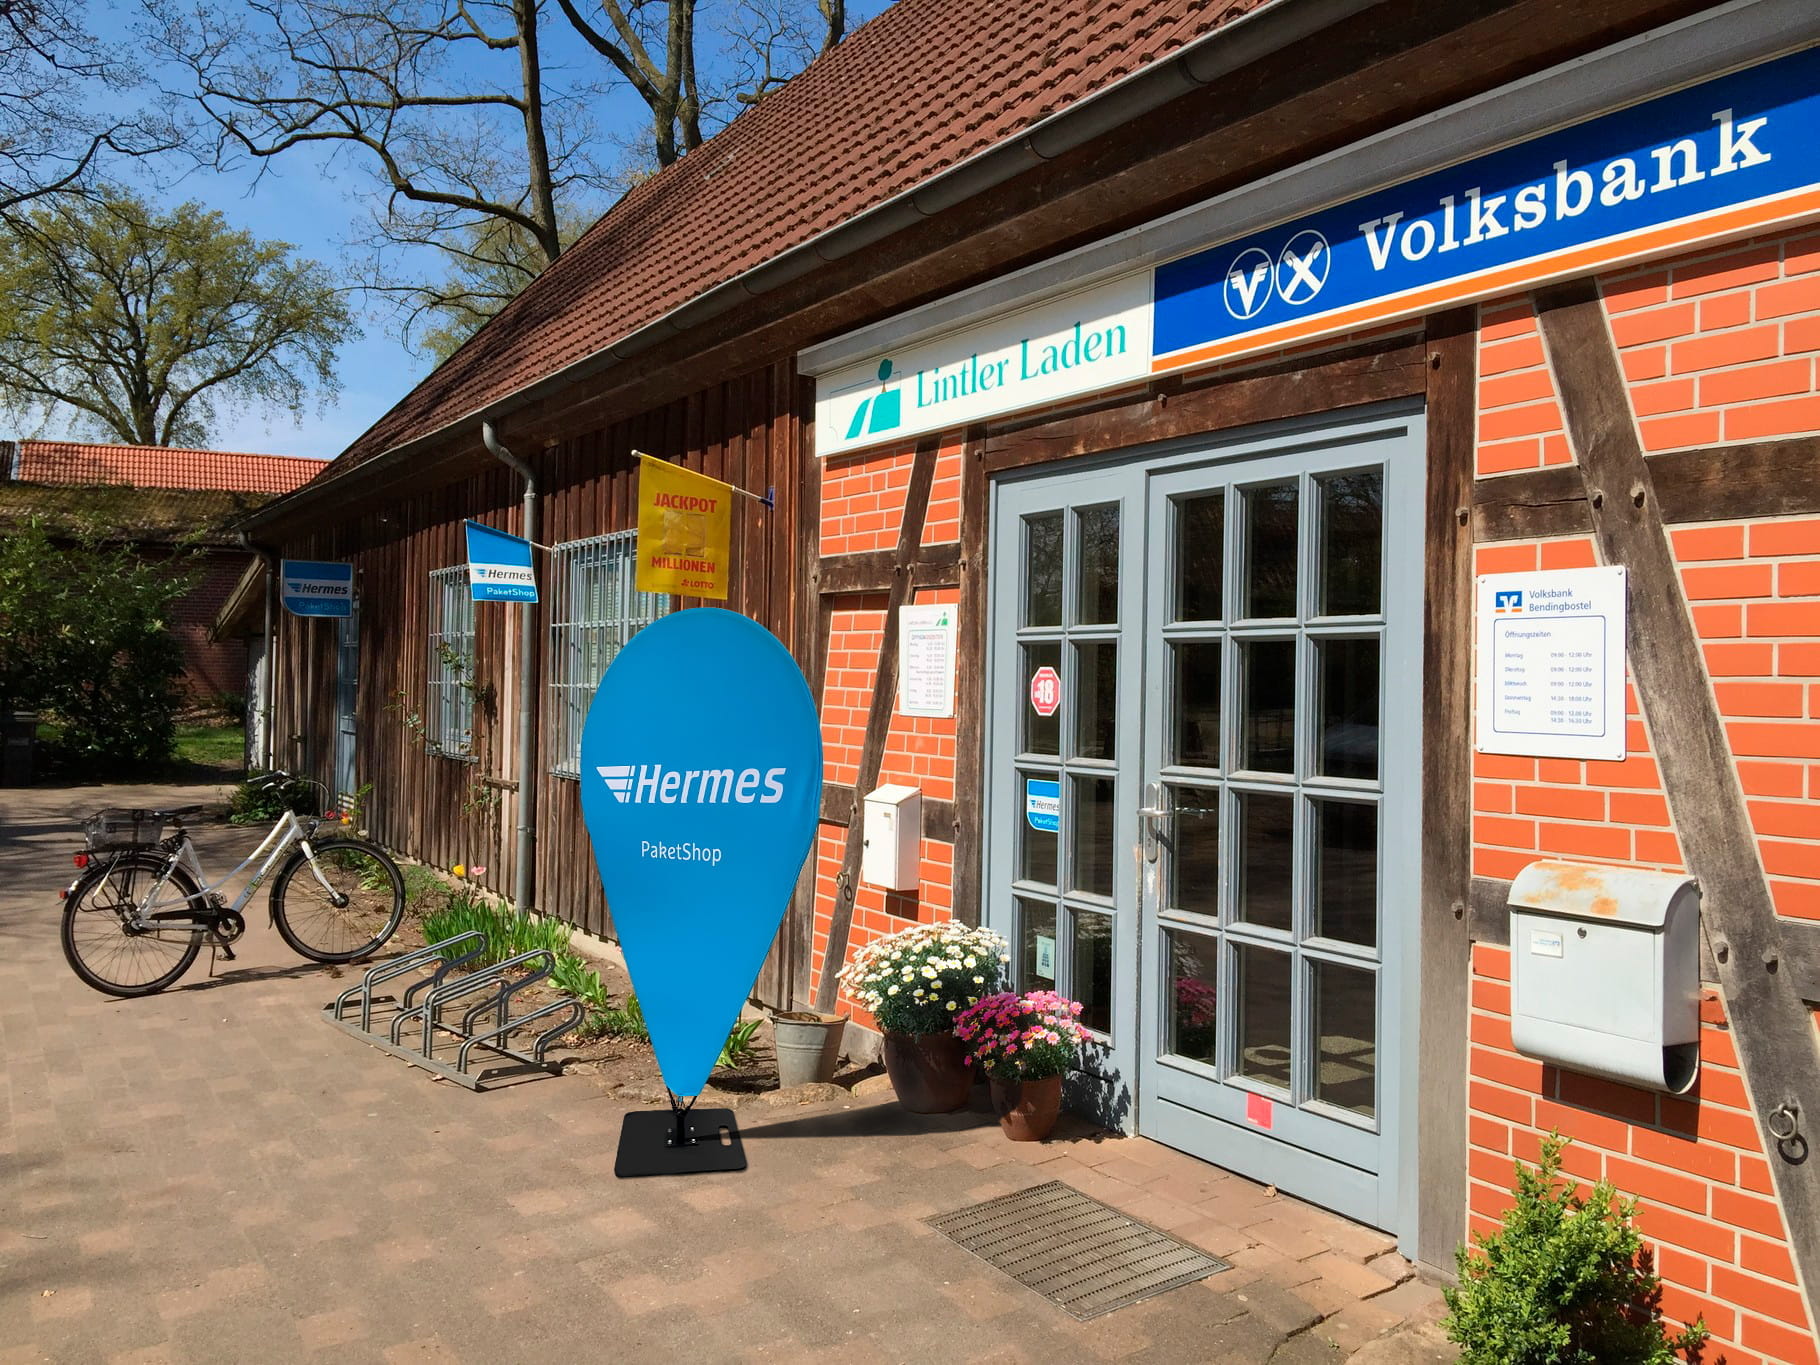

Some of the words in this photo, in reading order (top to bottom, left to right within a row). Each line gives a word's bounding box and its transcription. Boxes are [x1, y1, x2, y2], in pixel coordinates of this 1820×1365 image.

[1358, 108, 1771, 271] Volksbank
[916, 353, 1009, 408] Lintler
[1020, 321, 1127, 380] Laden
[654, 493, 718, 513] JACKPOT
[651, 556, 716, 574] MILLIONEN
[488, 569, 533, 581] Hermes
[302, 583, 348, 595] Hermes
[690, 580, 714, 589] LOTTO
[487, 587, 535, 597] PaketShop
[1529, 588, 1573, 599] Volksbank
[1529, 601, 1592, 613] Bendingbostel
[1504, 630, 1552, 639] Öffnungszeiten
[634, 764, 787, 804] Hermes
[641, 840, 722, 866] PaketShop
